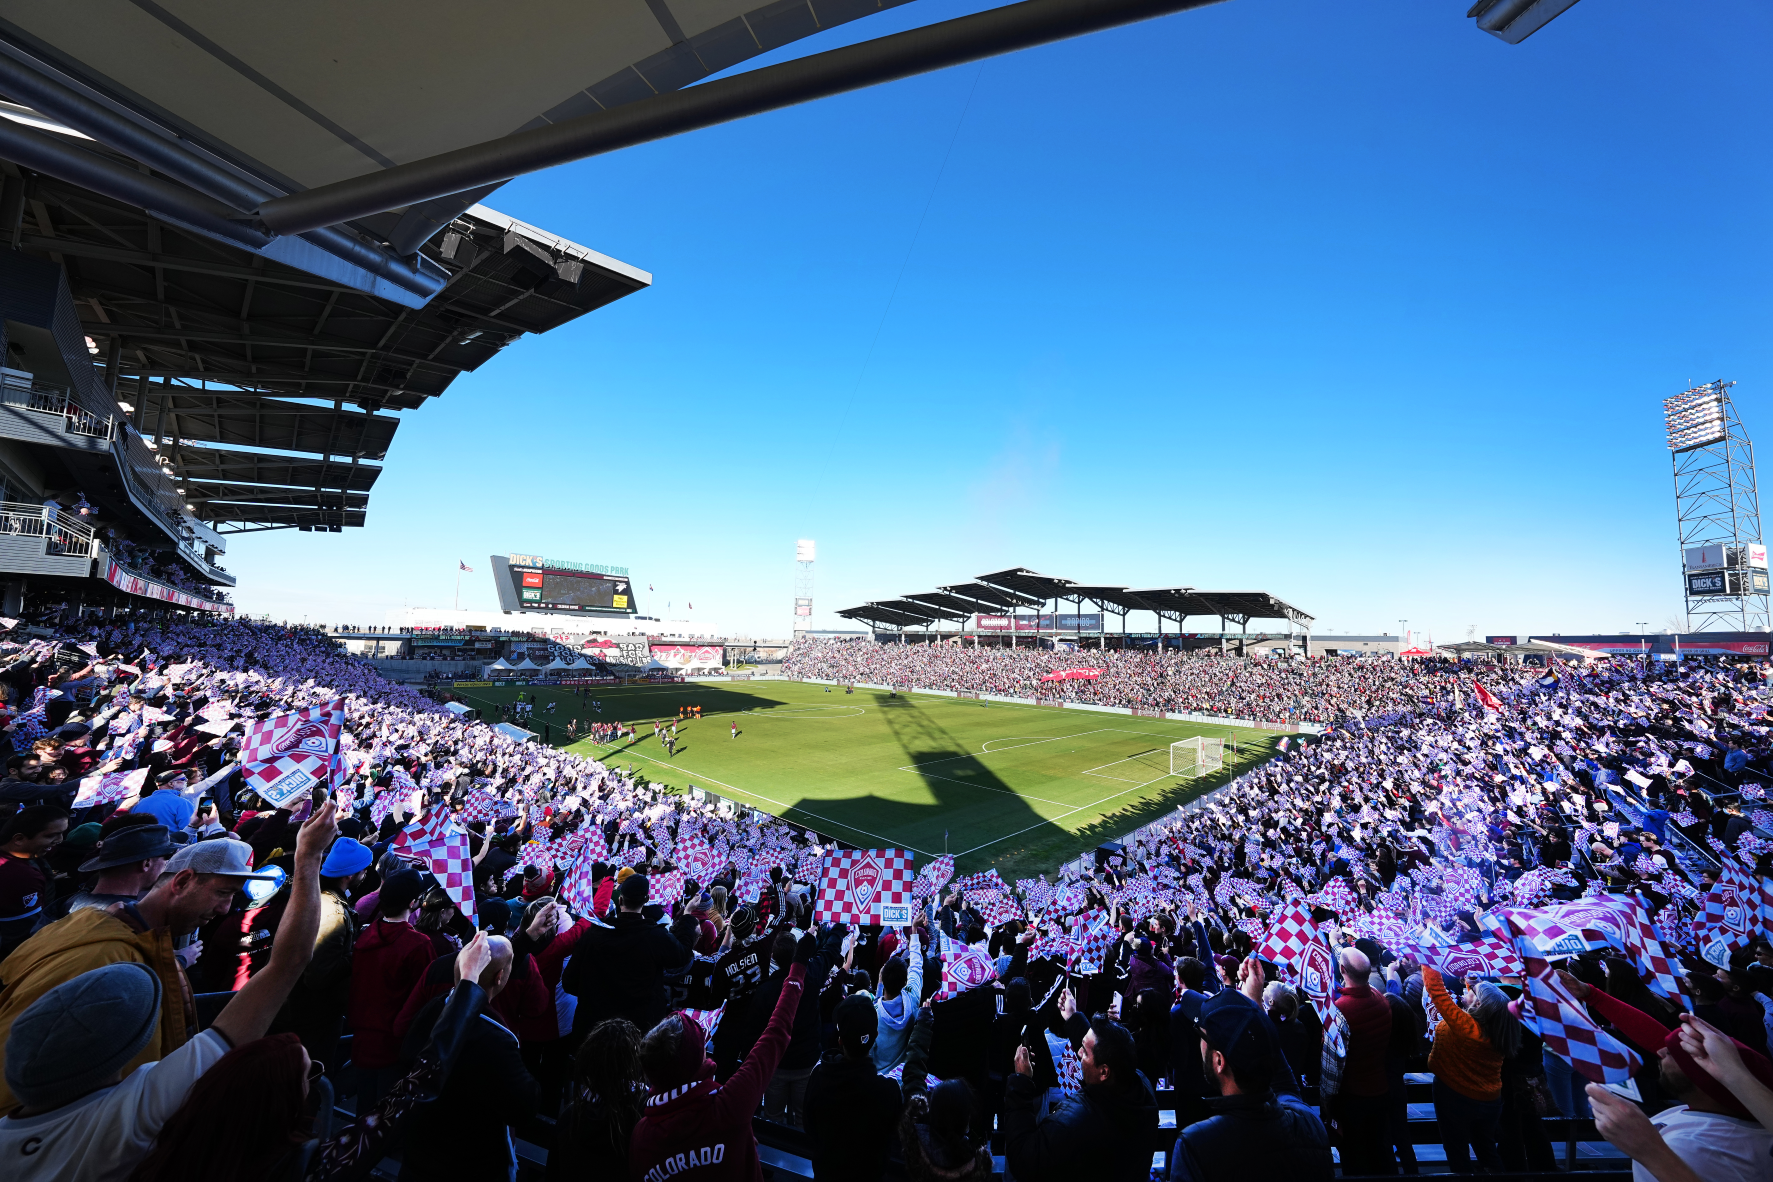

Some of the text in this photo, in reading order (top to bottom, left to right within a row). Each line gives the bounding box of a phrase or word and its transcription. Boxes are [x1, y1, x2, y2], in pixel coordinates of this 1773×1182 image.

[509, 553, 543, 567] DICK'S
[544, 558, 582, 571] SPORTING
[584, 563, 609, 574] GOODS
[610, 566, 629, 576] PARK
[1692, 577, 1722, 589] DICK'S
[1066, 617, 1090, 627] RAPIDS
[547, 644, 582, 652] GOOD
[619, 643, 645, 651] BAD
[884, 908, 908, 919] DICK'S
[725, 953, 759, 977] HOLSTEIN
[21, 1136, 43, 1156] C
[643, 1143, 725, 1182] COLORADO
